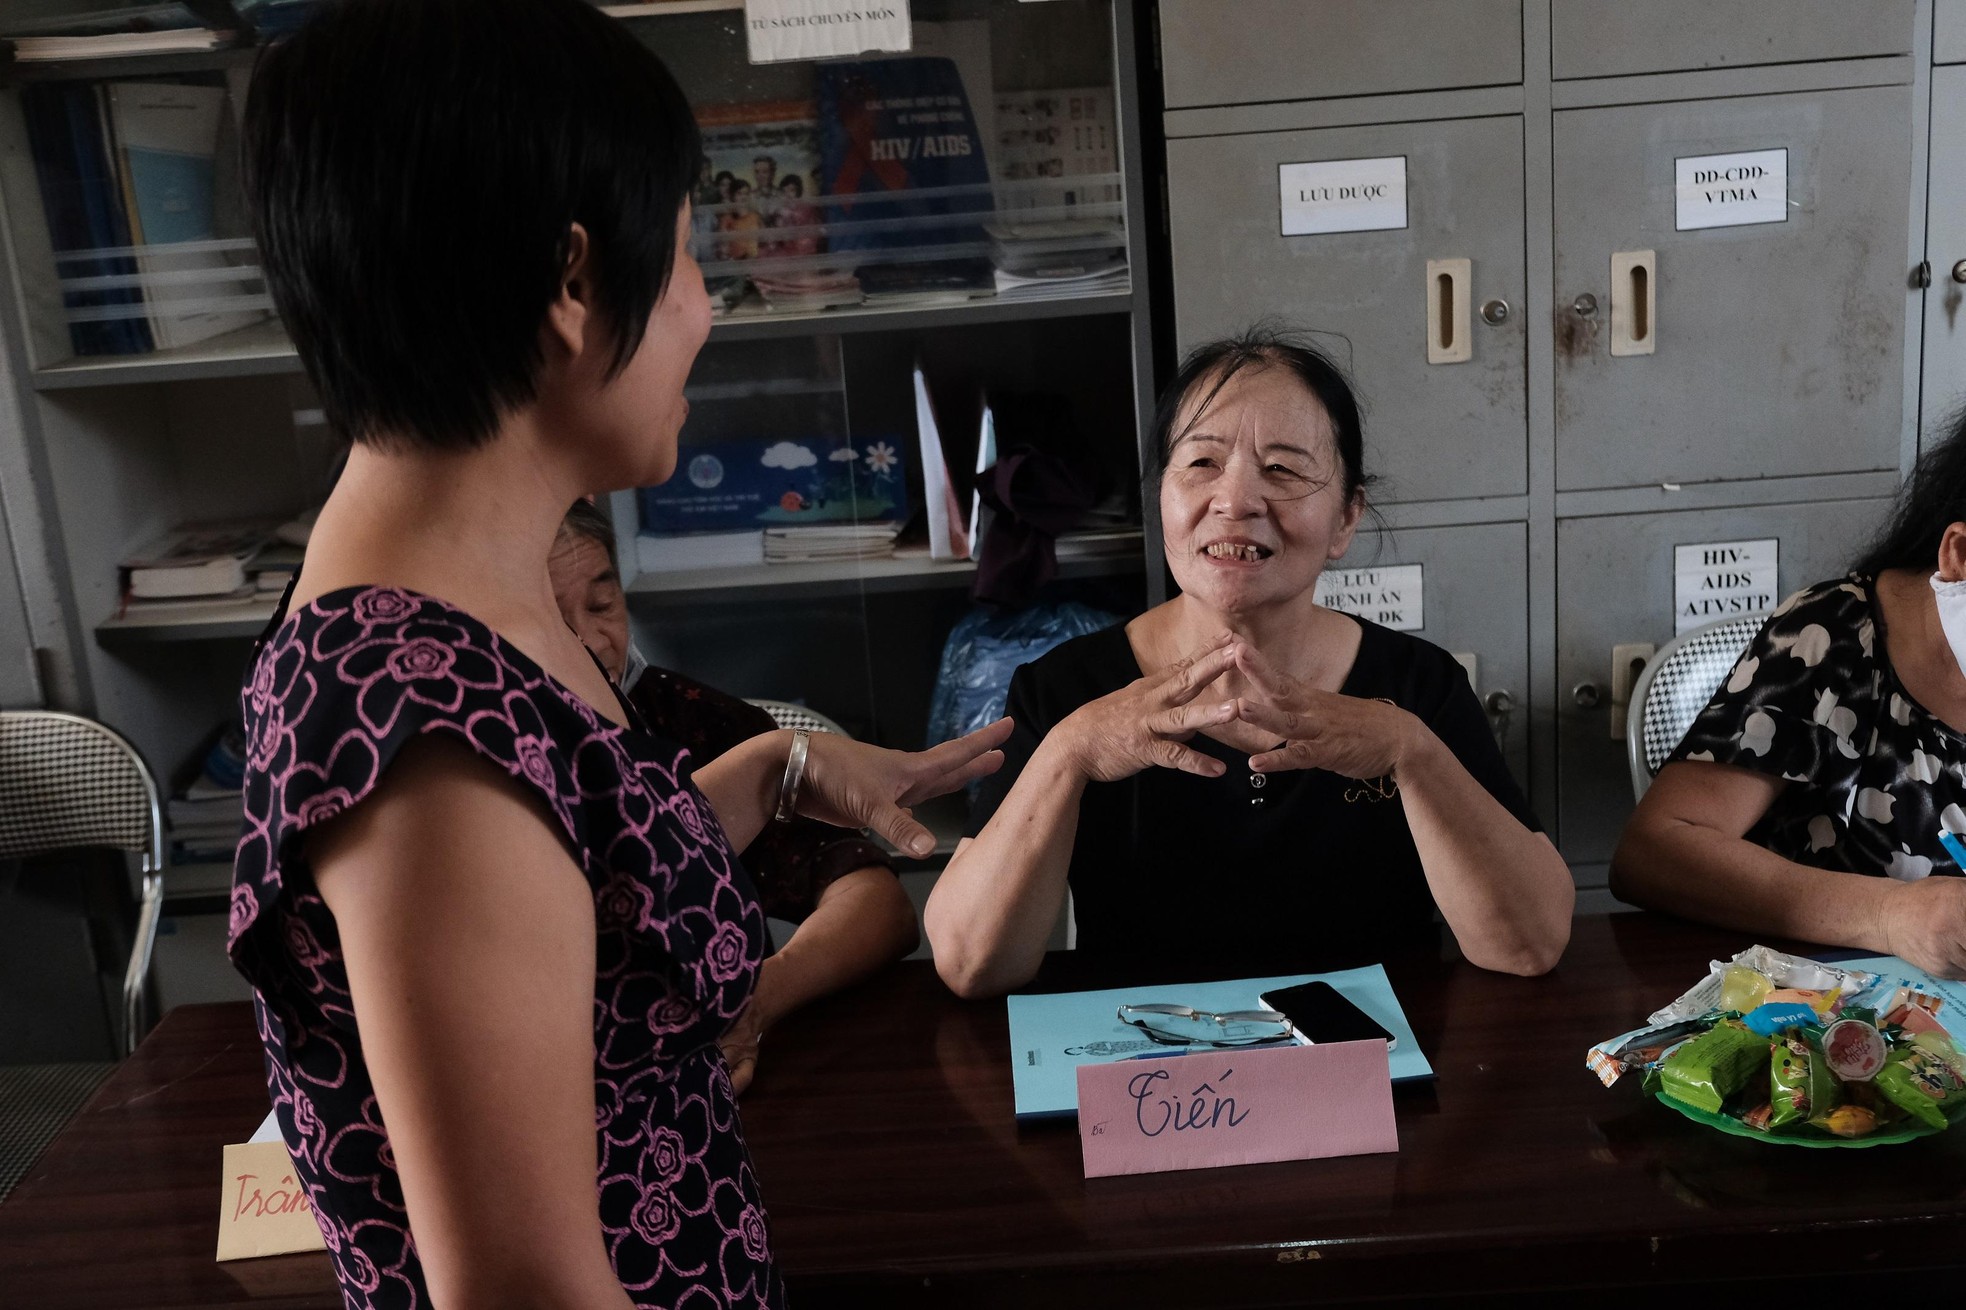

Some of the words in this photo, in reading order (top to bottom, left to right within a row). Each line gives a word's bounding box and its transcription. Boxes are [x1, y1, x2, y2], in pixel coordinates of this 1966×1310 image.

[771, 14, 806, 28] SÁCH
[870, 135, 971, 161] HIV/AIDS
[1300, 186, 1334, 202] LƯU
[1339, 184, 1388, 201] DƯỢC
[1705, 188, 1758, 204] VTMA
[1704, 548, 1751, 565] HIV-
[1701, 571, 1752, 590] AIDS
[1683, 594, 1770, 616] ATVSTP
[1128, 1069, 1250, 1136] Tiến
